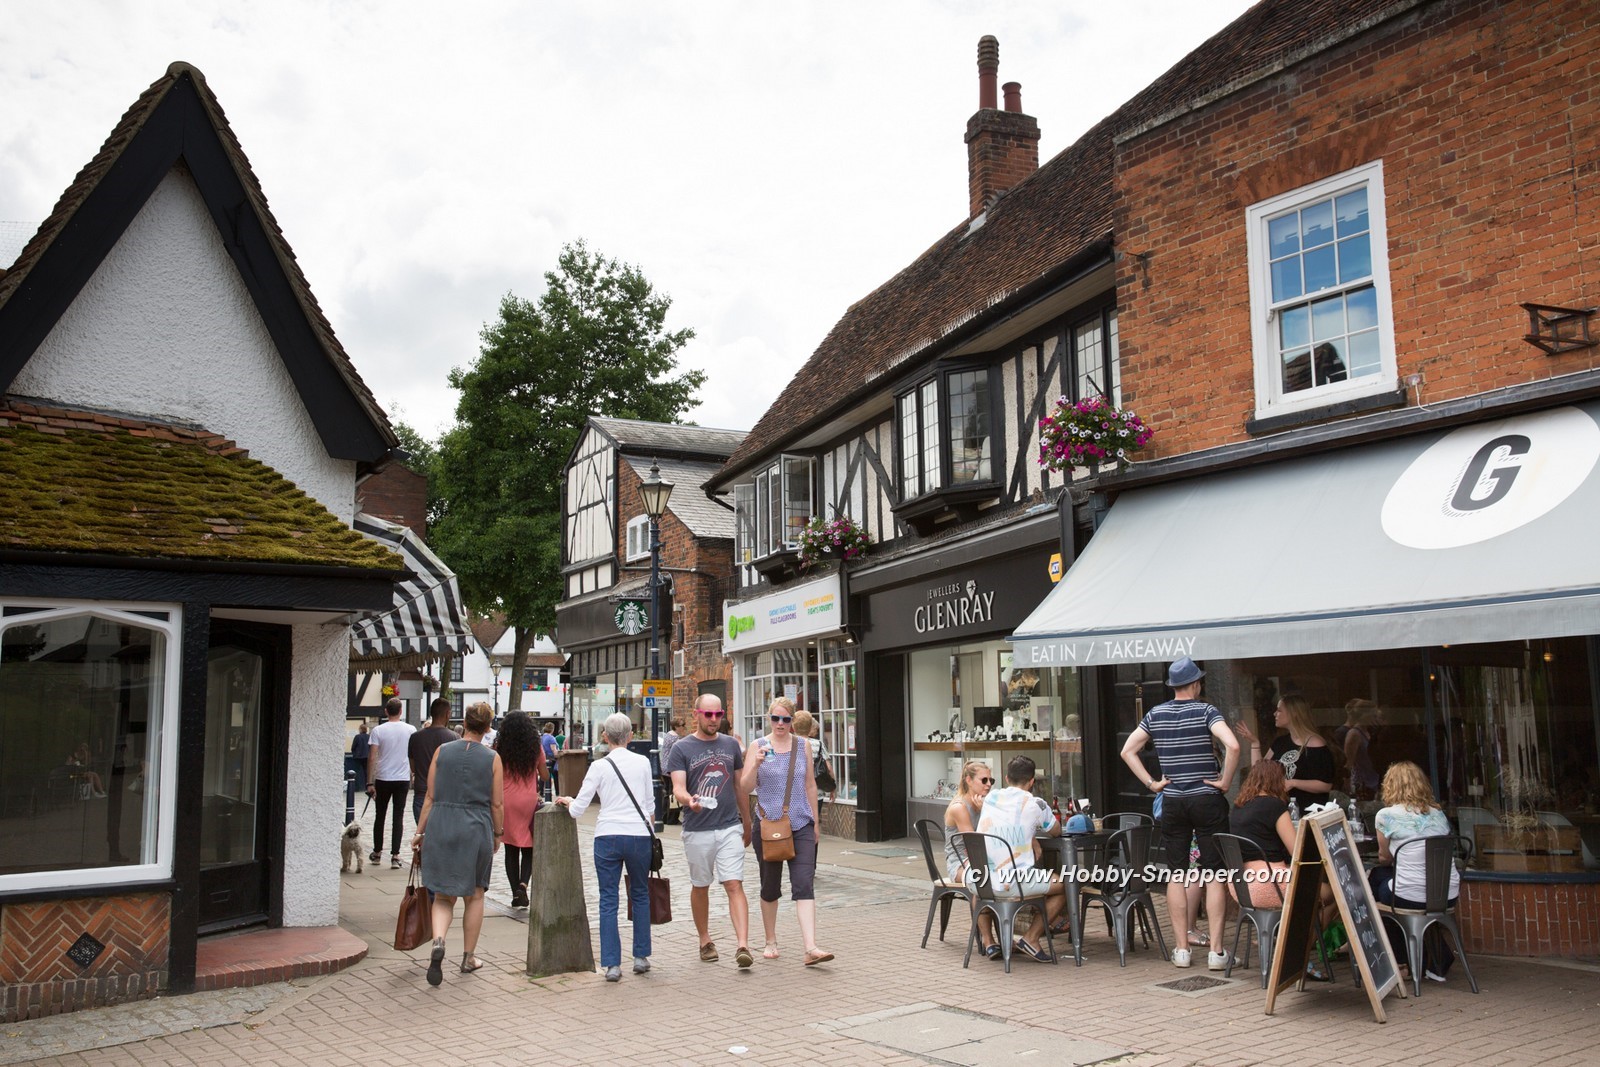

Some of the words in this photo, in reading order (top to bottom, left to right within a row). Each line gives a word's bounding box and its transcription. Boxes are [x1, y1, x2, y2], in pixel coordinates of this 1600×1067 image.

[1450, 434, 1532, 512] G
[927, 582, 961, 601] JEWELLERS
[914, 590, 995, 634] GLENRAY
[1031, 644, 1056, 663] EAT
[1060, 643, 1076, 662] IN
[1104, 636, 1196, 659] TAKEAWAY
